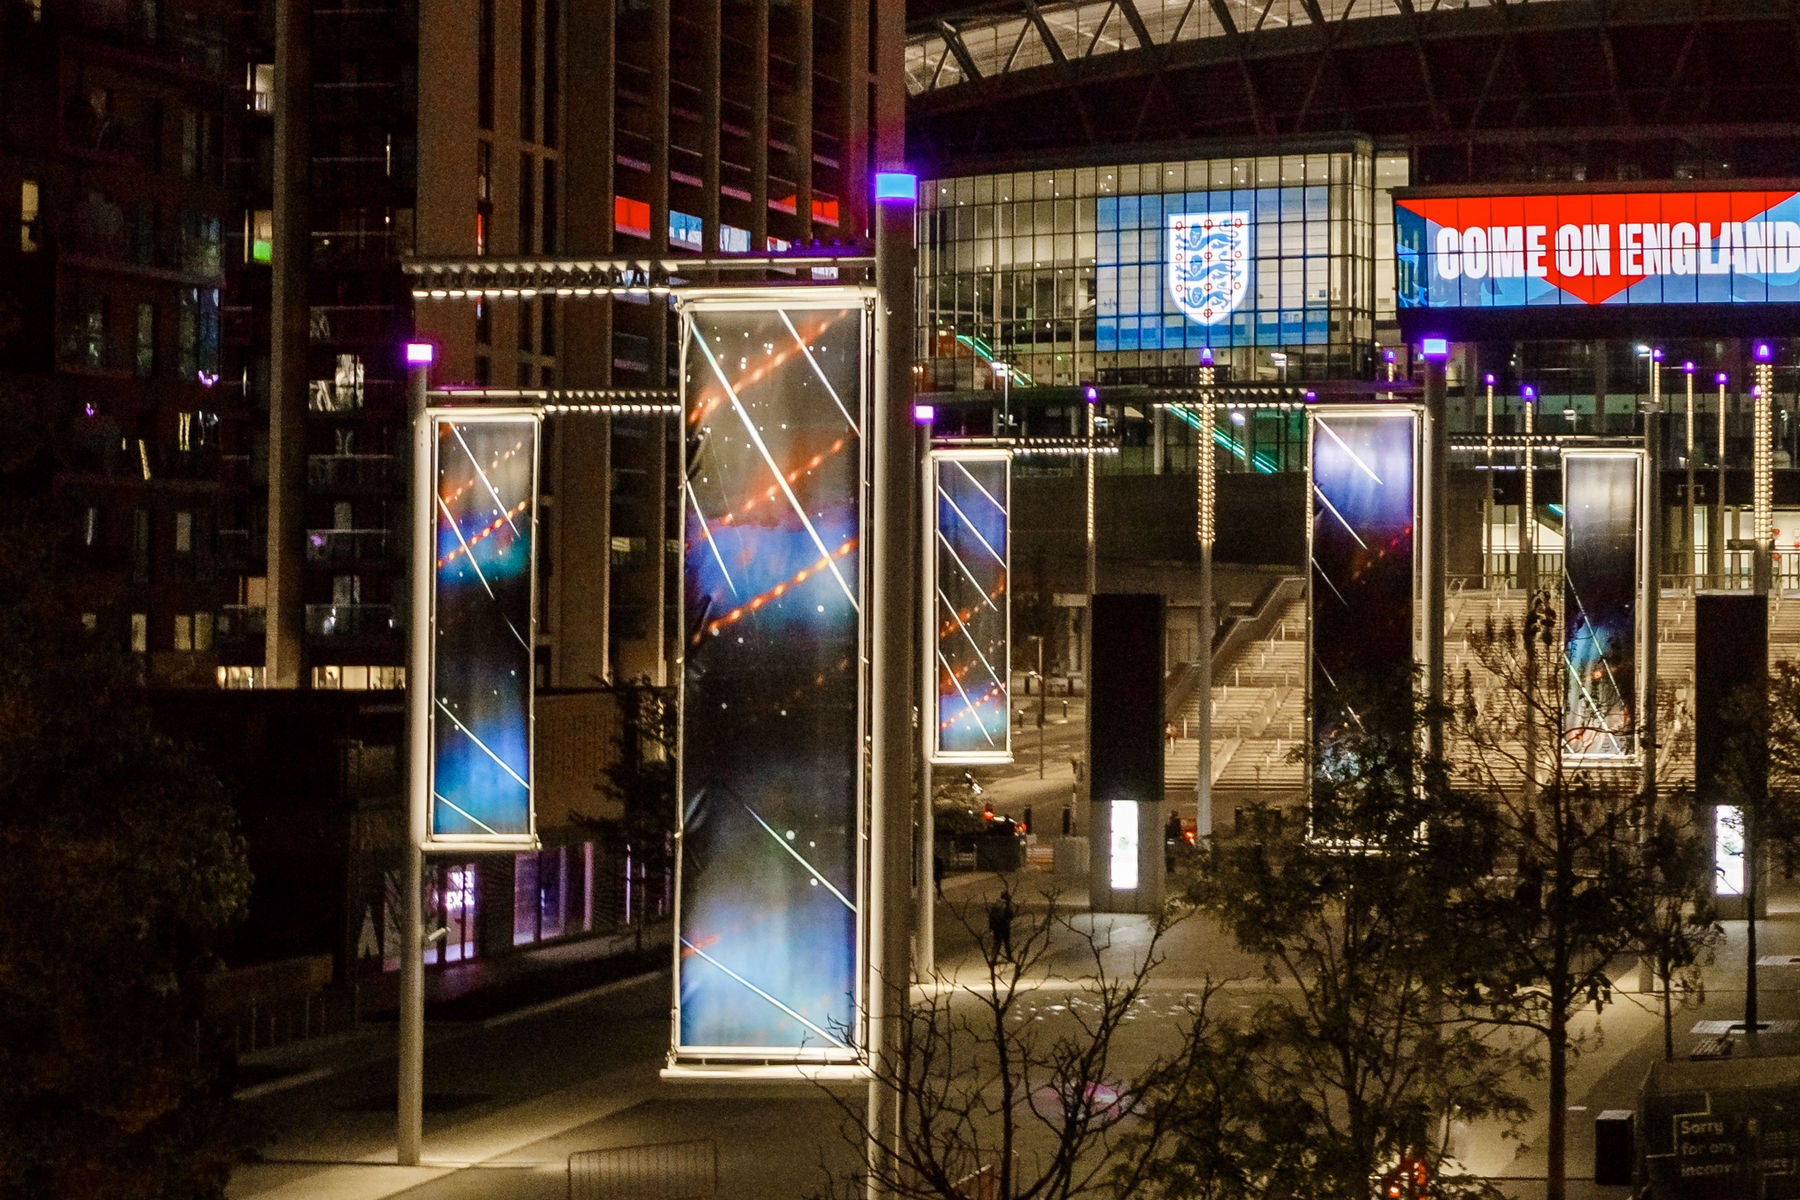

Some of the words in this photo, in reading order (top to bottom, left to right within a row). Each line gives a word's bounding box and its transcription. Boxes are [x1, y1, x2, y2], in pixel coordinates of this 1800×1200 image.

[1436, 226, 1547, 279] COME
[1555, 224, 1610, 276] ON
[1680, 1120, 1725, 1135] Sorry
[1681, 1142, 1706, 1155] for
[1709, 1143, 1735, 1155] any
